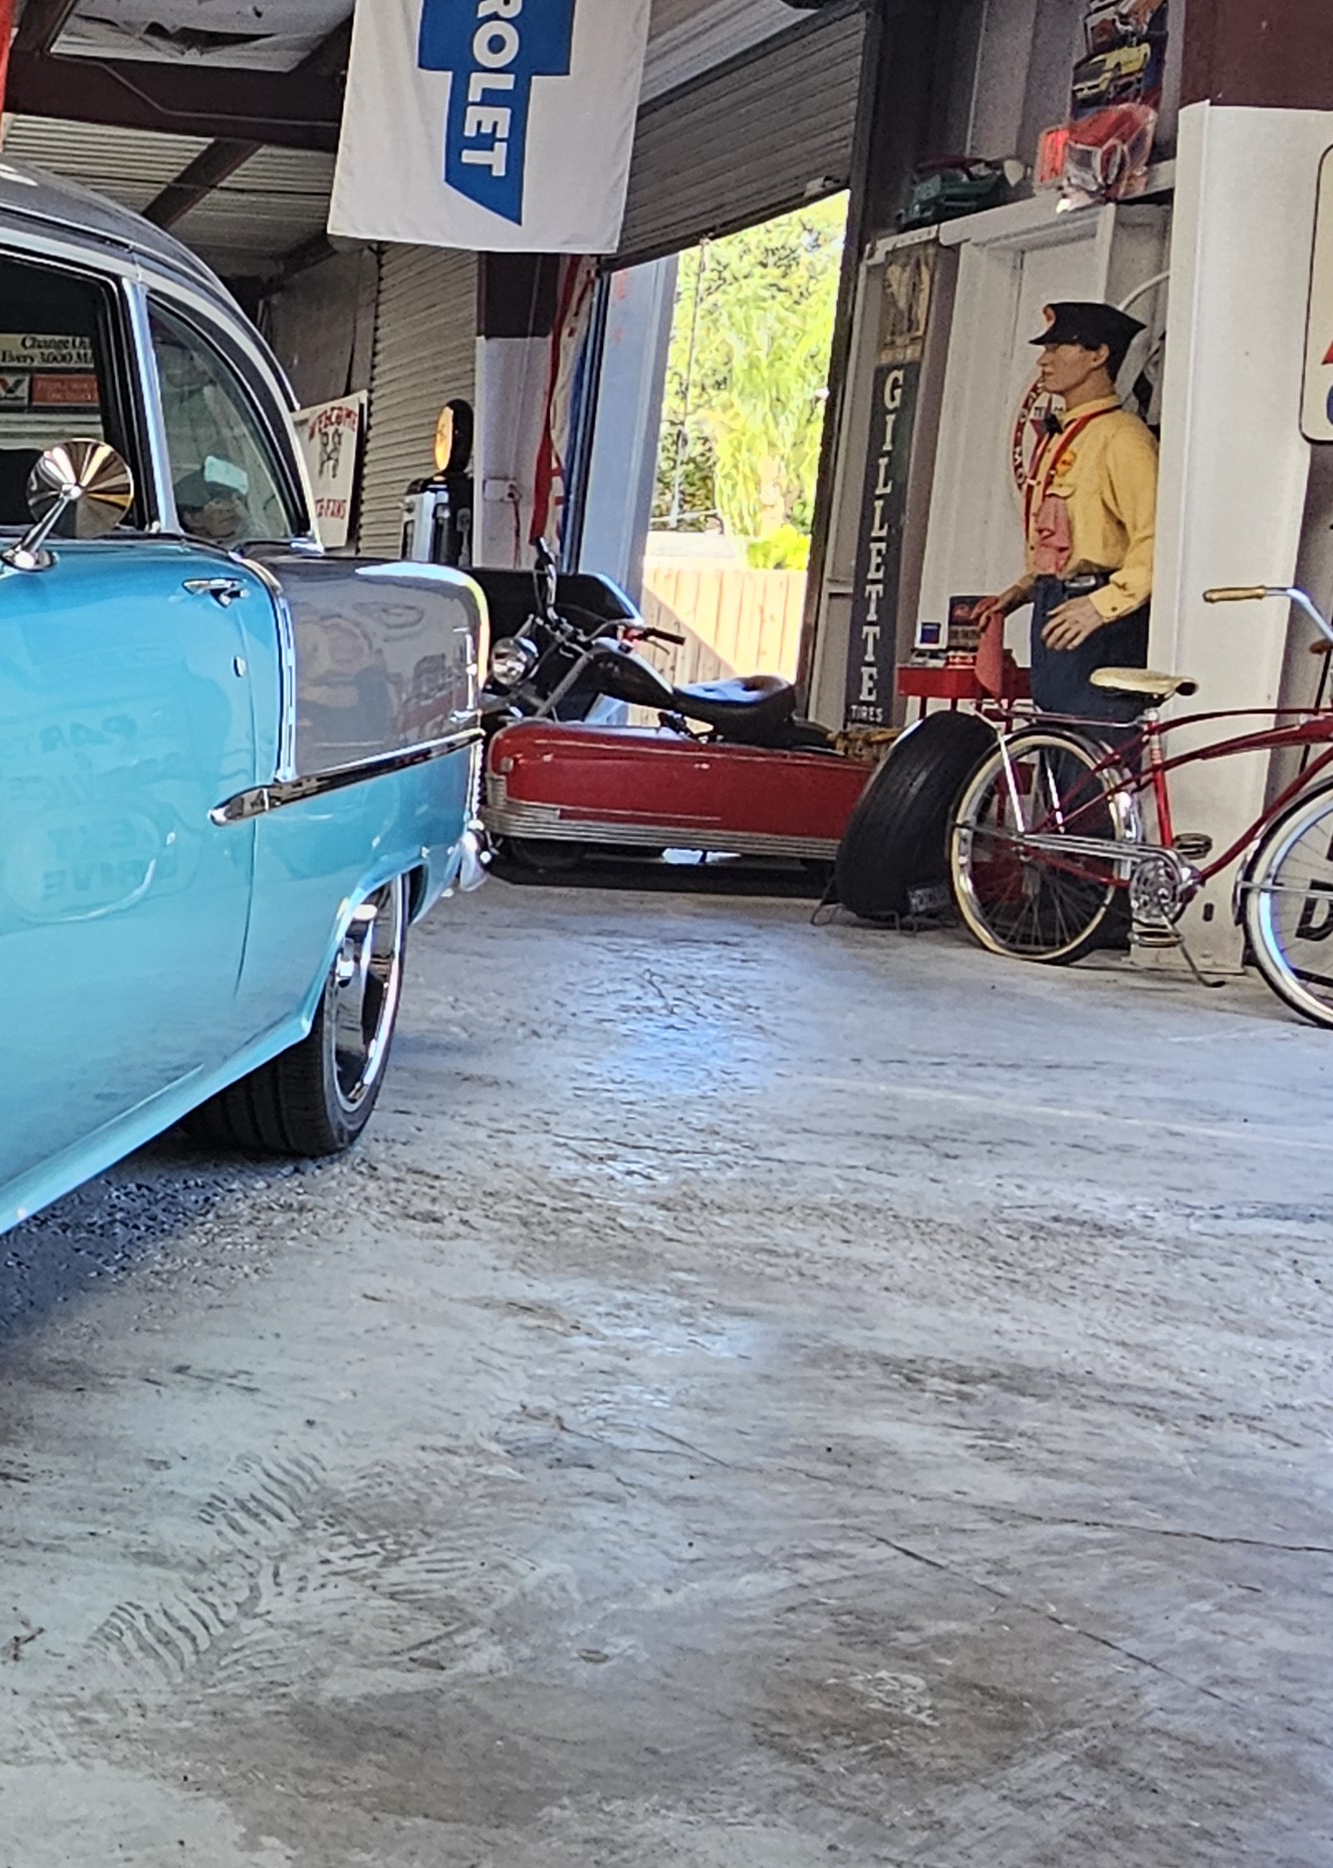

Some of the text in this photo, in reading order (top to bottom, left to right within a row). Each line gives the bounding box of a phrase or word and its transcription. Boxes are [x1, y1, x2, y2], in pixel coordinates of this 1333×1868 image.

[21, 336, 71, 352] Change
[859, 369, 907, 702] GILLETTE
[850, 704, 884, 724] TIRES
